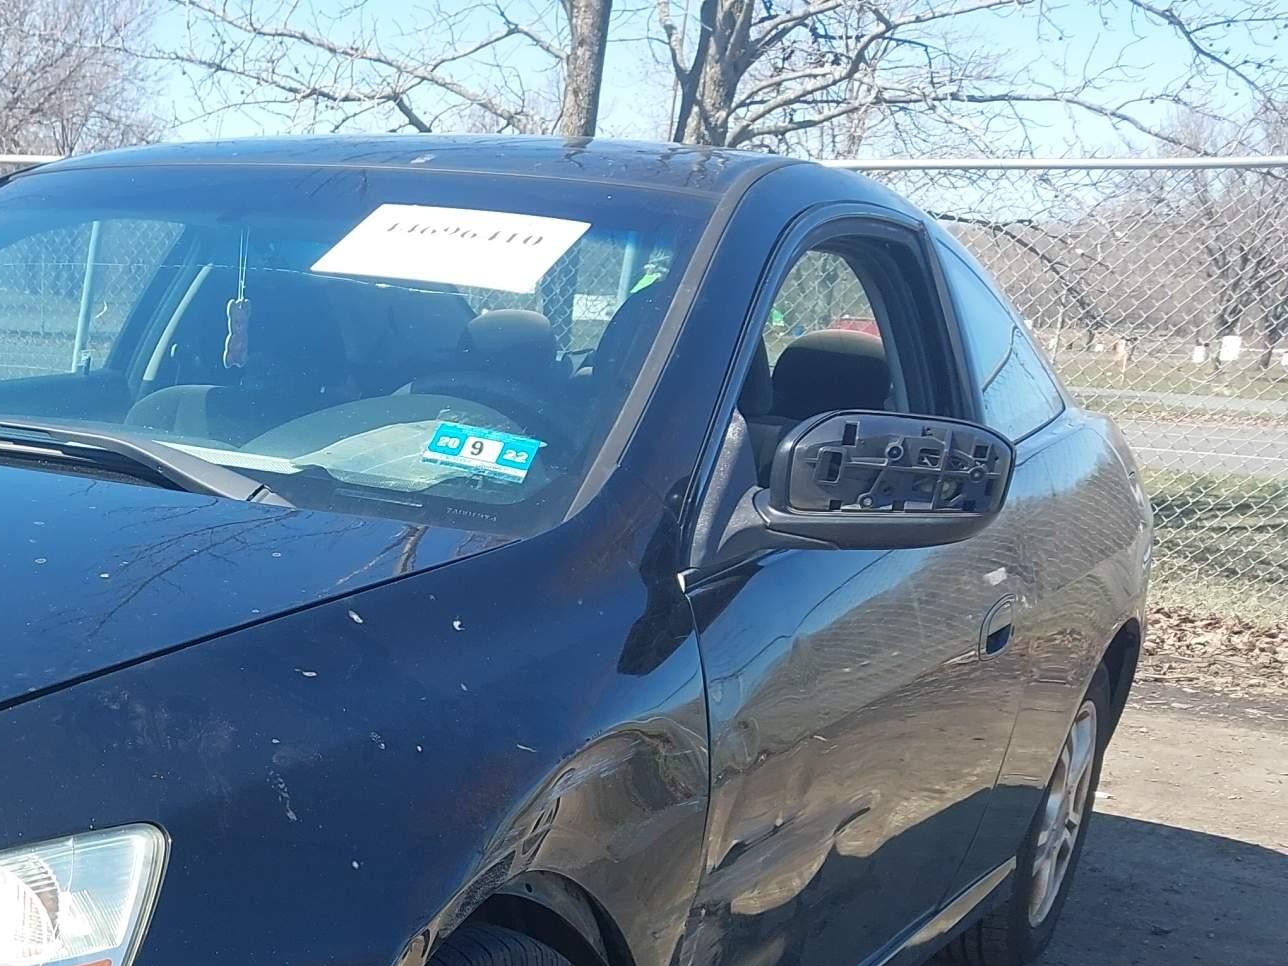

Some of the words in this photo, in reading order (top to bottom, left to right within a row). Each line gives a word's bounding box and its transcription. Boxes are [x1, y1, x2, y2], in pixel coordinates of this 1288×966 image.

[436, 436, 461, 450] 20
[470, 440, 484, 456] 9
[502, 449, 529, 464] 22
